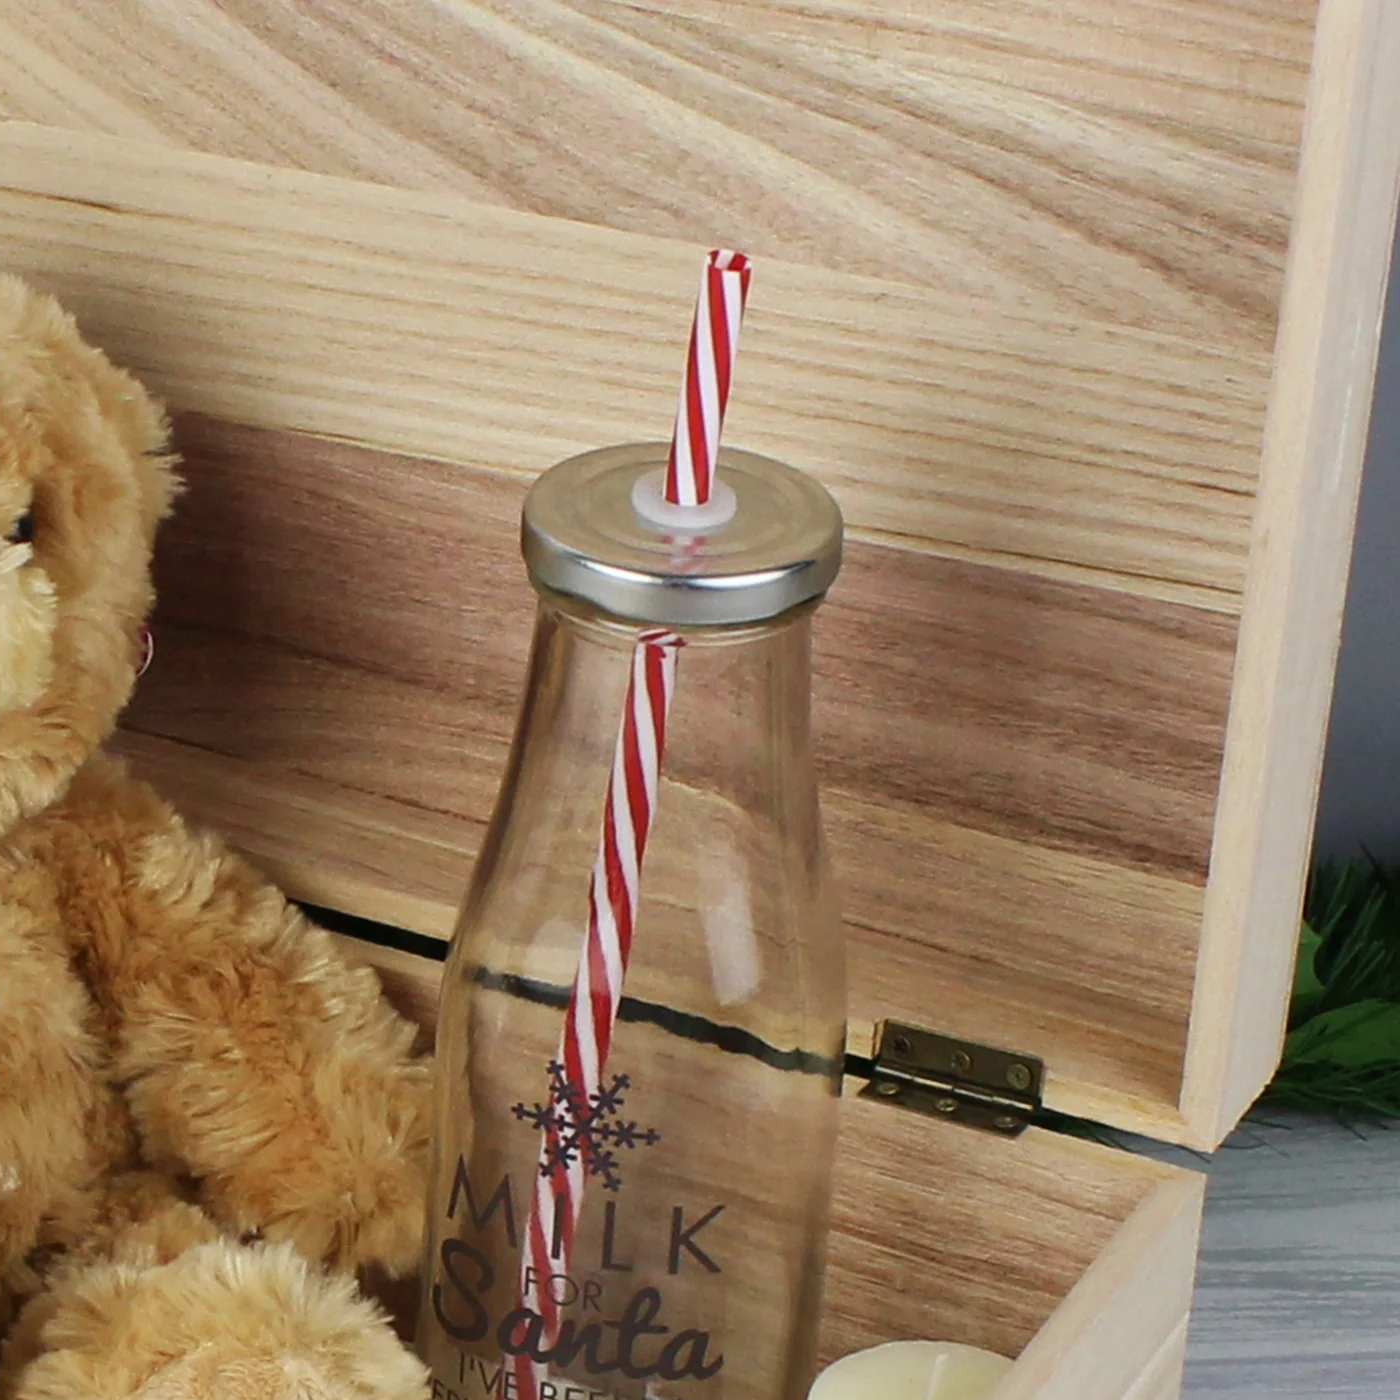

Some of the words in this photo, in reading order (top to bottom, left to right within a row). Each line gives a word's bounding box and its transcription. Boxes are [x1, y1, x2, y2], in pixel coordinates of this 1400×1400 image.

[445, 1153, 726, 1276] MILK
[433, 1238, 725, 1381] Santa
[523, 1266, 602, 1313] FOR
